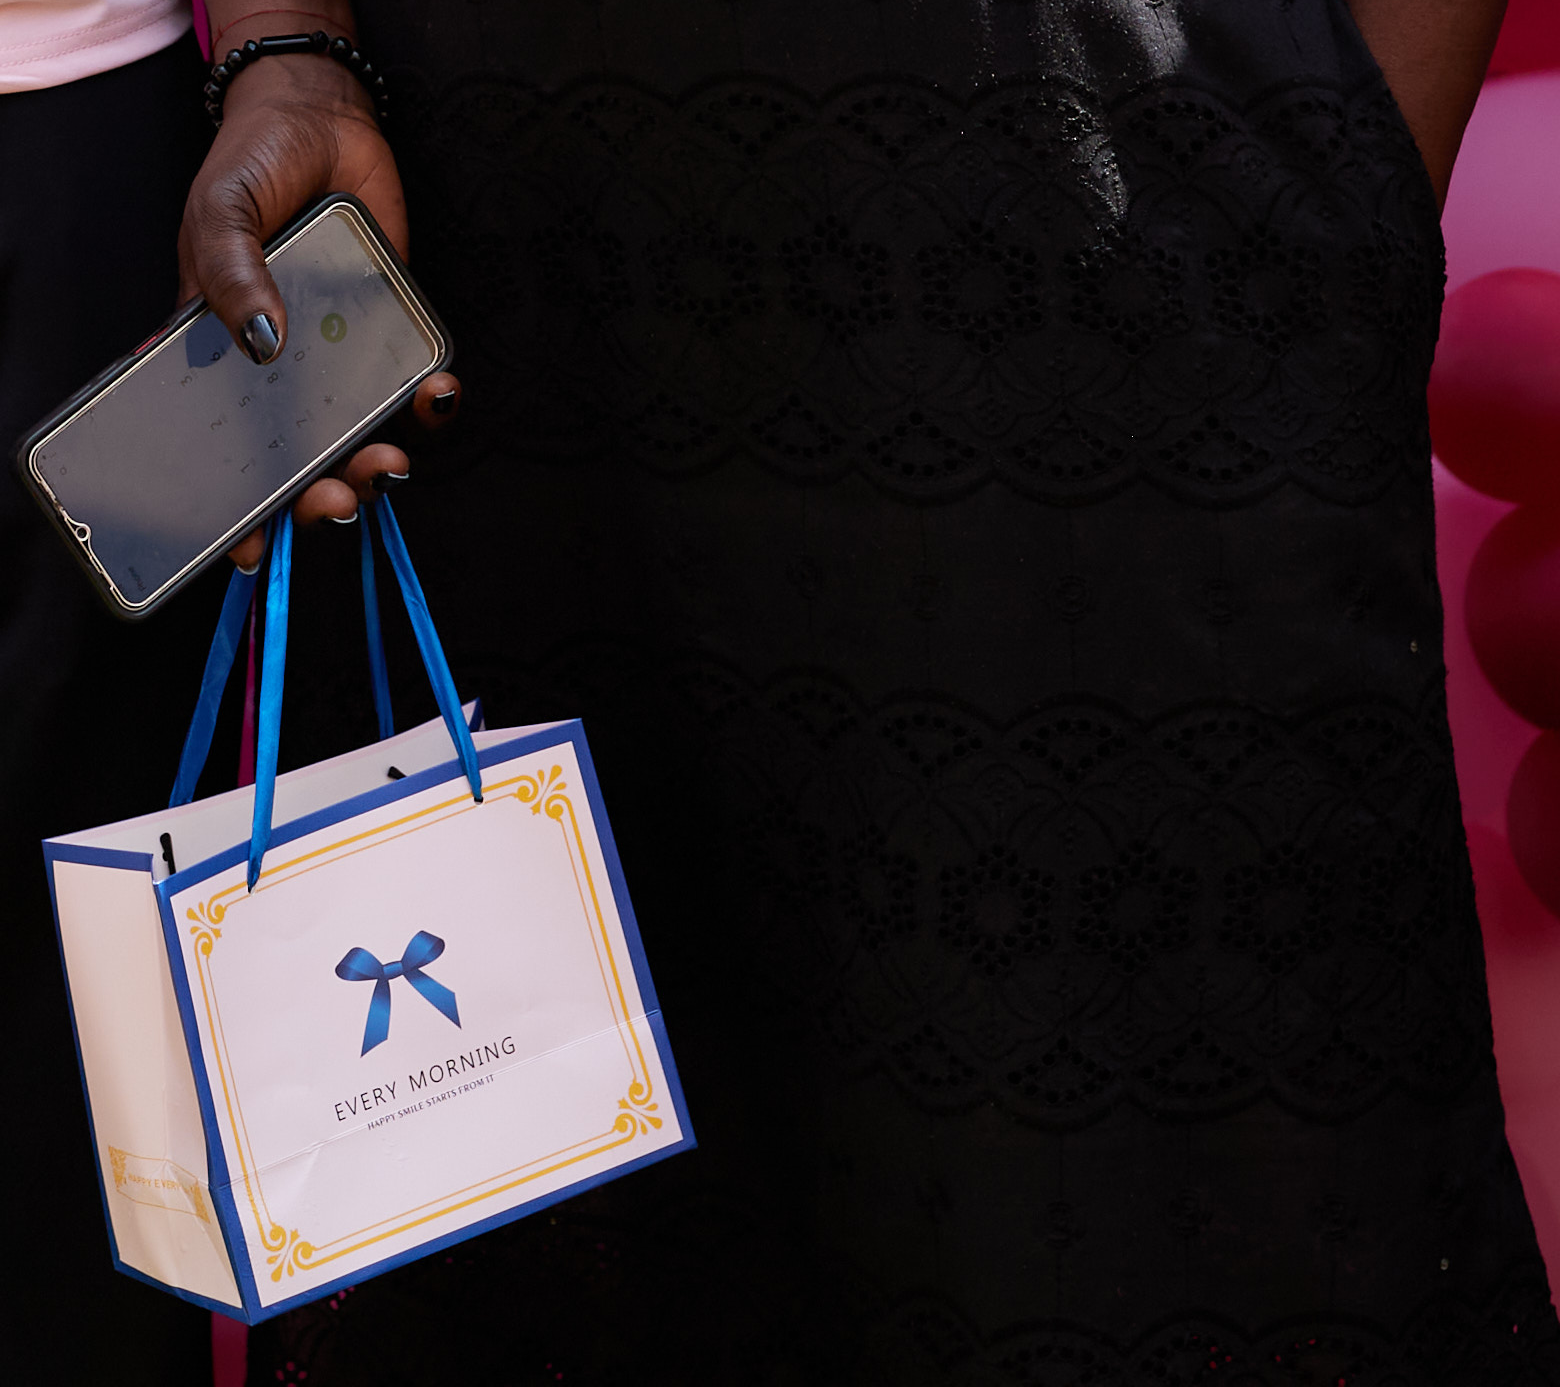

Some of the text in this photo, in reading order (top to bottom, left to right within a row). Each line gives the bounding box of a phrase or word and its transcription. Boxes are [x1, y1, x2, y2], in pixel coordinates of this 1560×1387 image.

[334, 1036, 516, 1122] EVERY MORNING
[367, 1074, 495, 1131] HAPPY SMILE STARTS FROM IT
